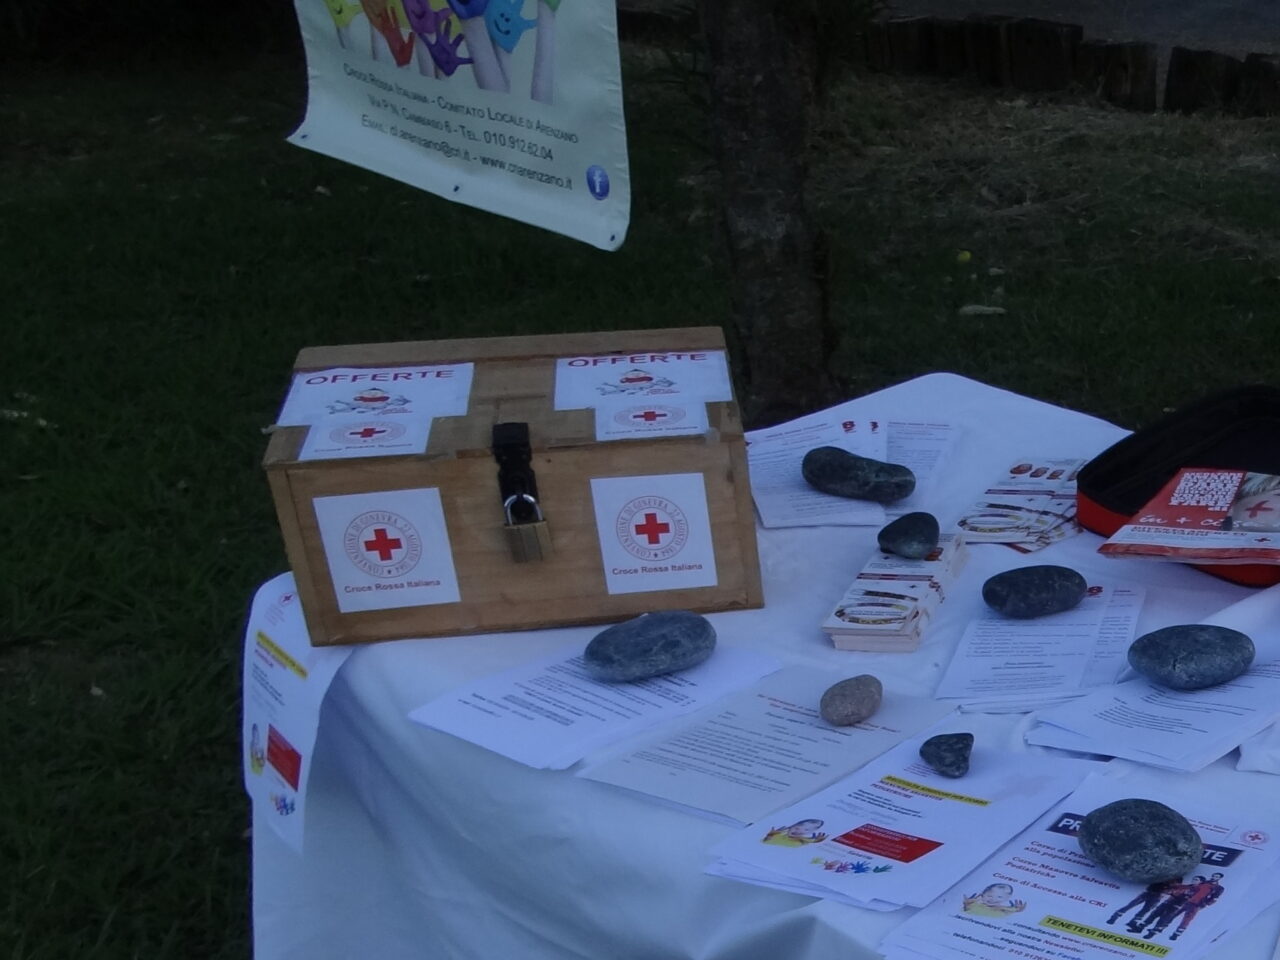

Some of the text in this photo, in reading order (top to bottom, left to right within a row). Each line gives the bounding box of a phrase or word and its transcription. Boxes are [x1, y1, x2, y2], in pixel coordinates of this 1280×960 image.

[568, 353, 708, 367] OFFERTE
[305, 370, 455, 385] OFFERTE
[612, 563, 704, 576] Croce Rossa Italiana
[344, 579, 441, 594] Croce Rossa Italiana
[1045, 917, 1098, 939] TENETEVI
[1098, 931, 1156, 953] INFORMATI
